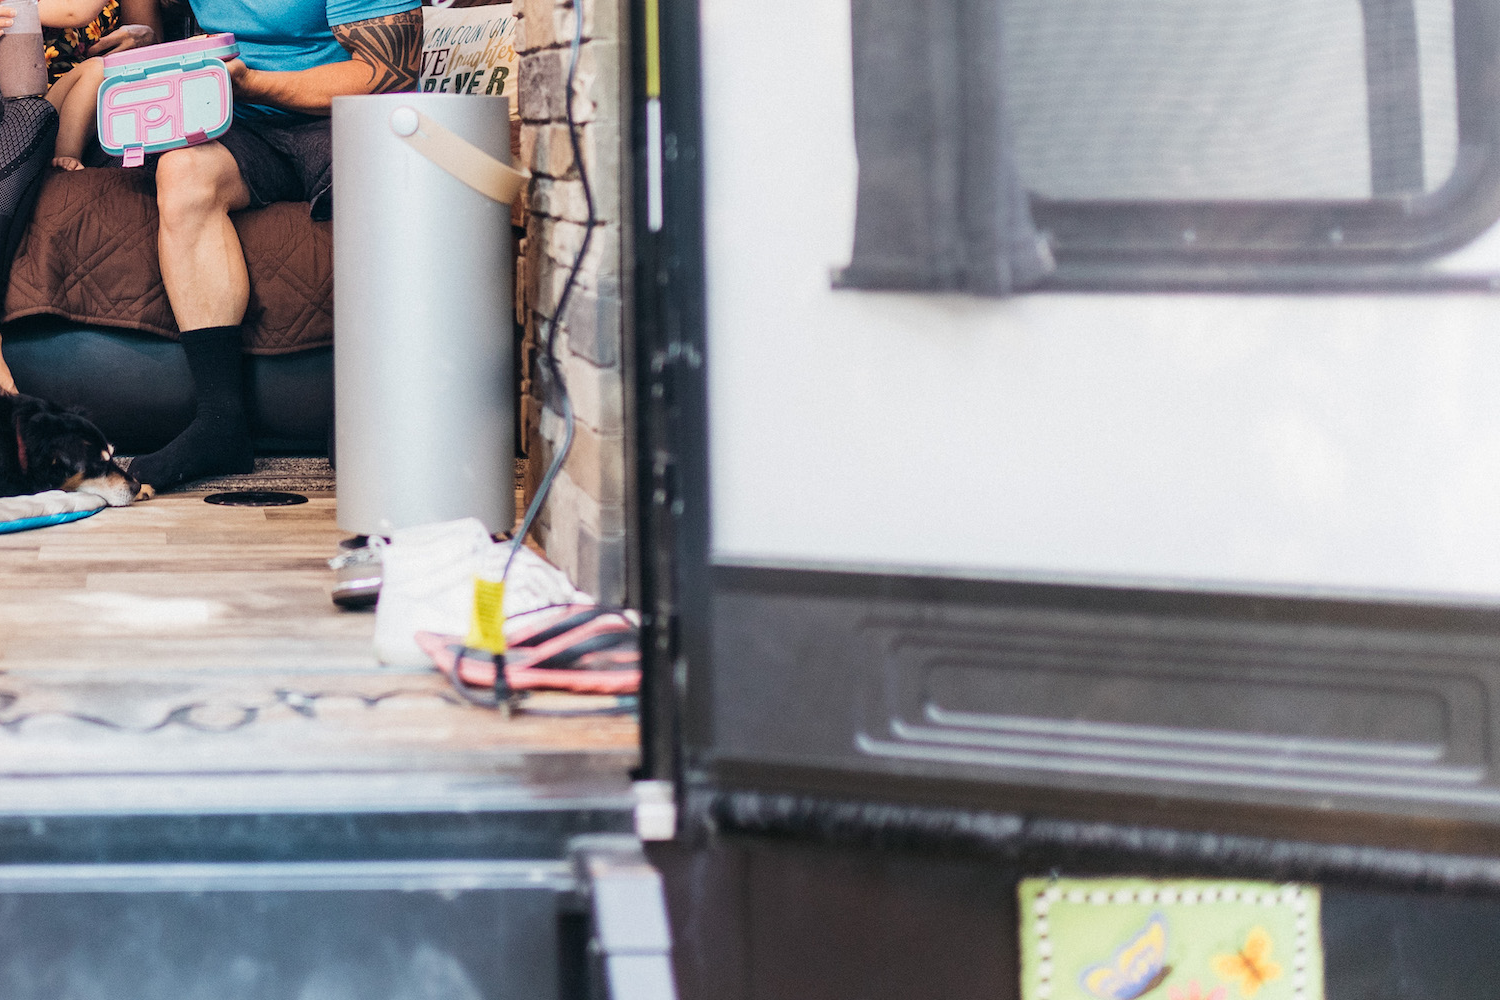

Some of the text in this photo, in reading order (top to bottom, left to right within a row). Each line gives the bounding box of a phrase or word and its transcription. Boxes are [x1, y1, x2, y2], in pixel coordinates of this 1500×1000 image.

[427, 26, 454, 48] CAN
[450, 19, 492, 46] COUNT
[489, 16, 512, 39] ON
[420, 47, 451, 78] VE
[445, 30, 518, 78] laughter
[422, 66, 510, 96] REVER
